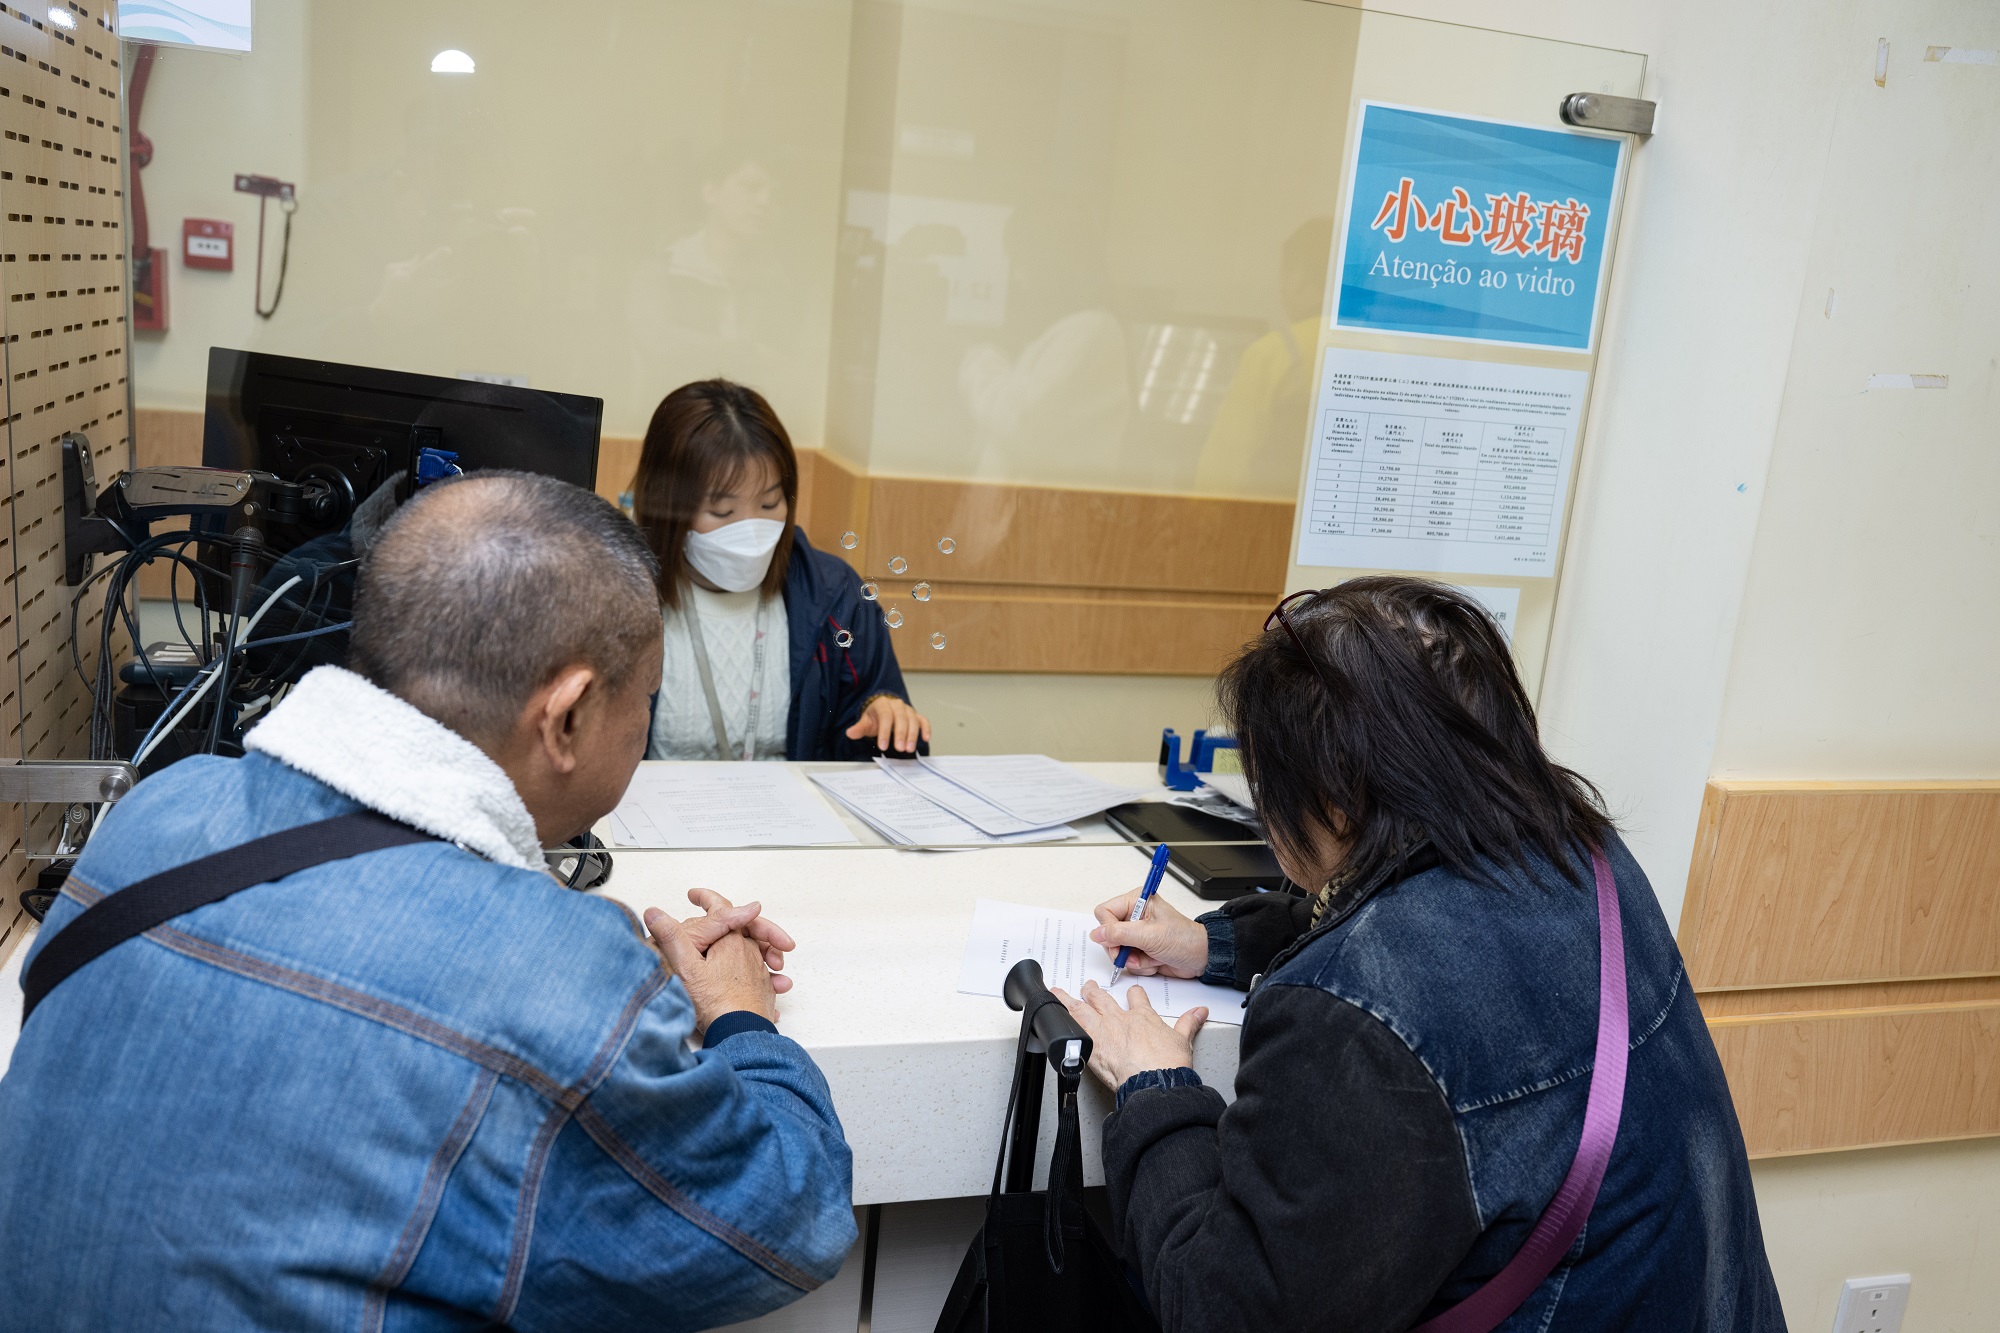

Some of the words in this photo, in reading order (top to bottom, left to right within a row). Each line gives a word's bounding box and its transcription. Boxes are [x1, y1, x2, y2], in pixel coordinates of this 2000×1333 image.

[1371, 177, 1589, 264] 小心玻璃
[1368, 250, 1470, 288] Atenção
[1478, 269, 1506, 289] ao
[1515, 266, 1575, 297] vidro
